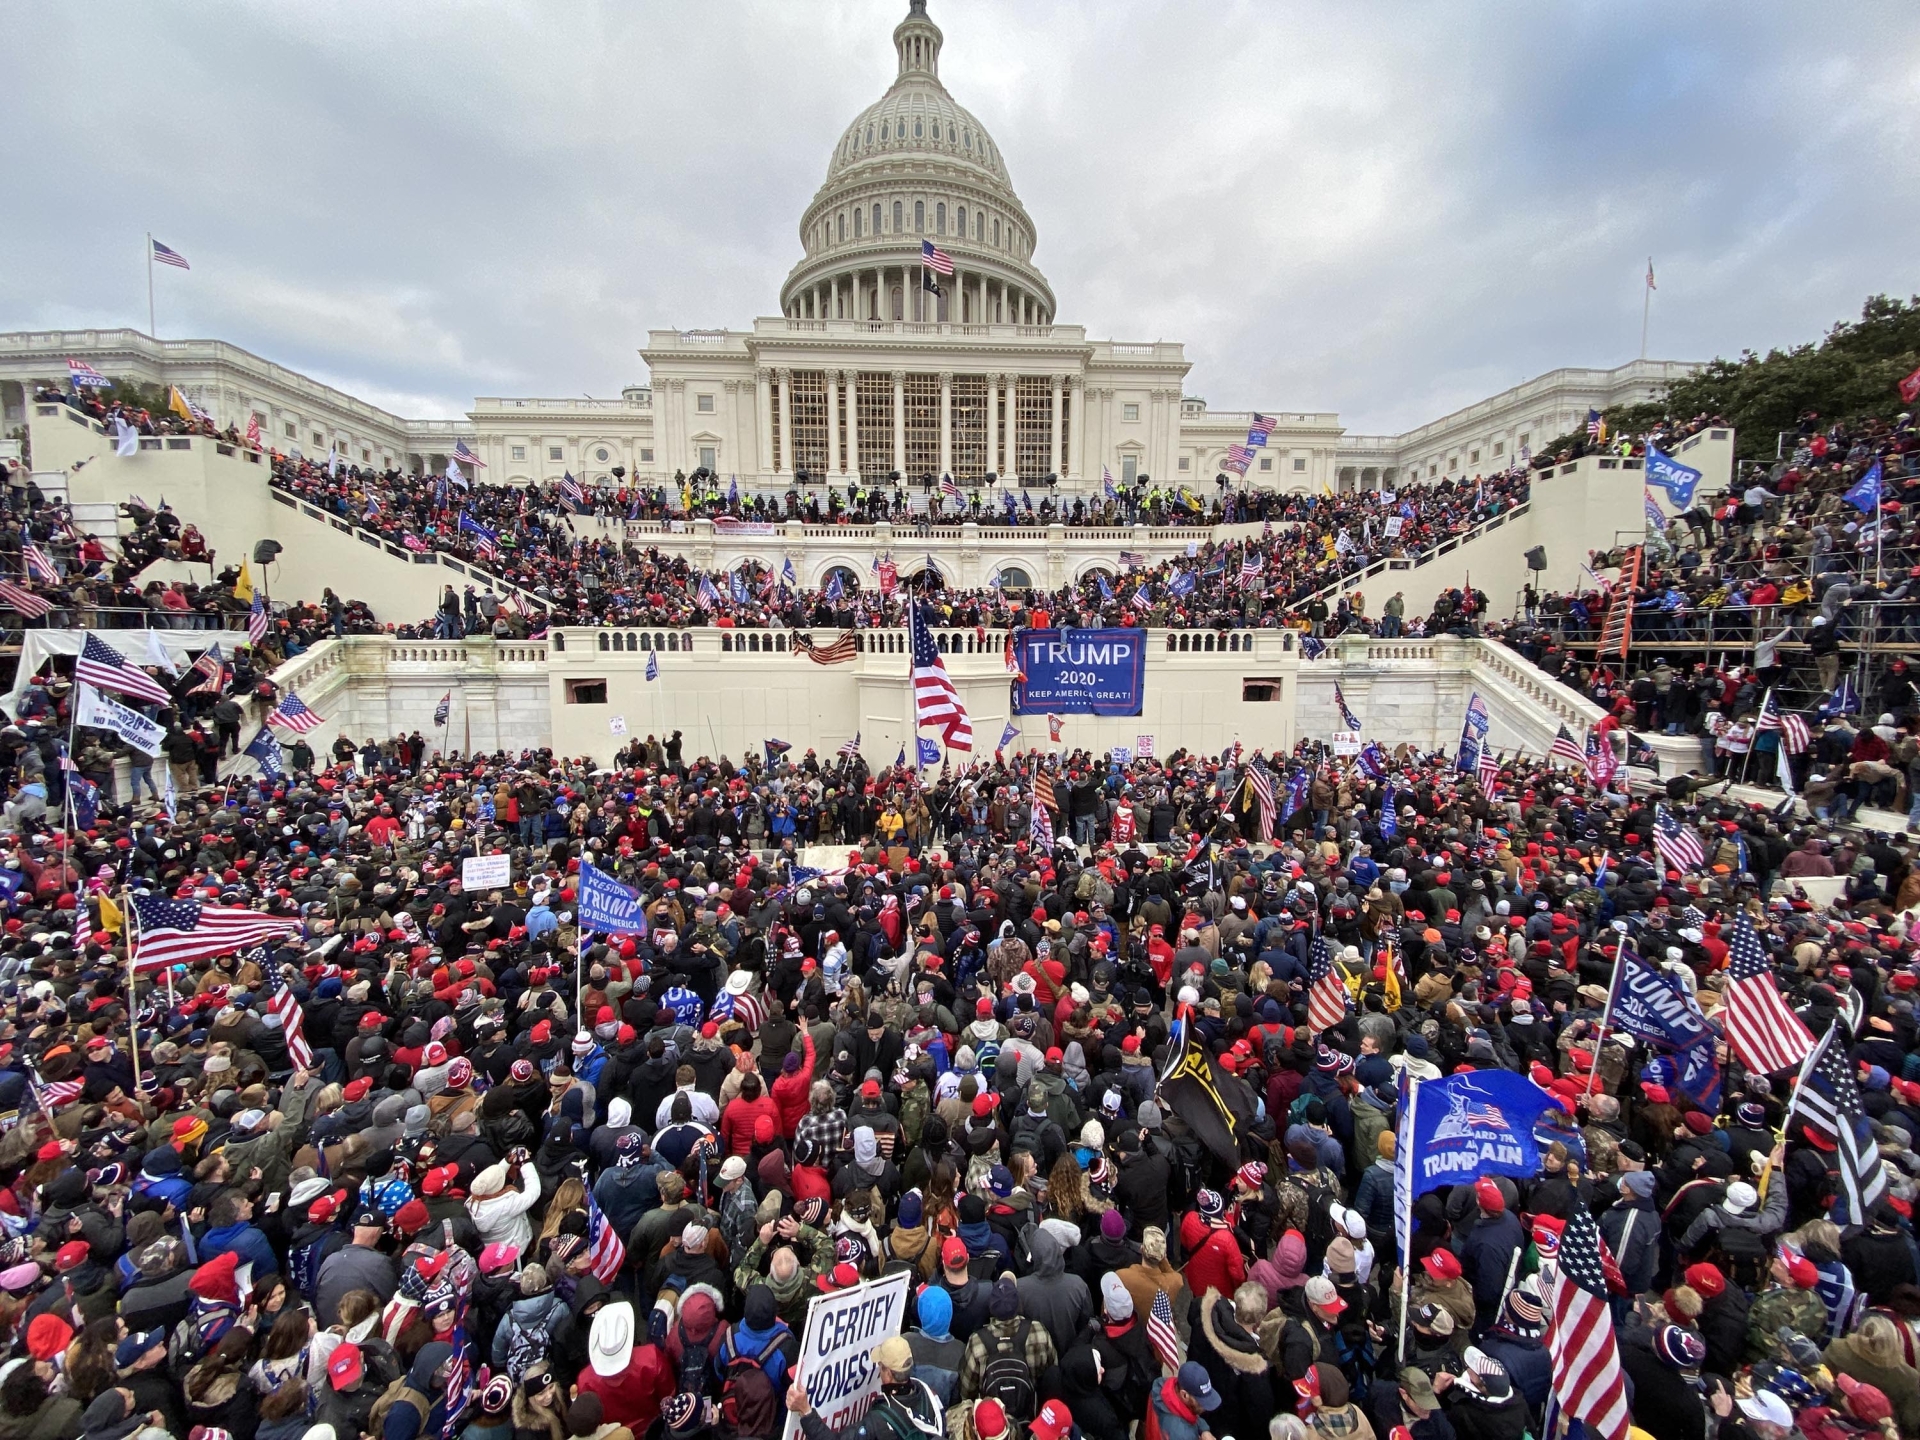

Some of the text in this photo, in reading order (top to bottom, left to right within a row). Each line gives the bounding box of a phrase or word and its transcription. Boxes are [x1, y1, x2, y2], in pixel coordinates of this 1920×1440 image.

[79, 376, 111, 387] 2020
[1028, 642, 1131, 665] TRUMP
[1029, 690, 1131, 699] KEEP AMERICA GREAT!
[93, 716, 106, 725] NO
[120, 727, 156, 750] BULLSHIT
[265, 752, 282, 773] 2020
[582, 886, 638, 918] TRUMP
[592, 910, 610, 924] BLESS
[1423, 1142, 1523, 1178] TRUMP AIN
[818, 1291, 897, 1357] CERTIFY
